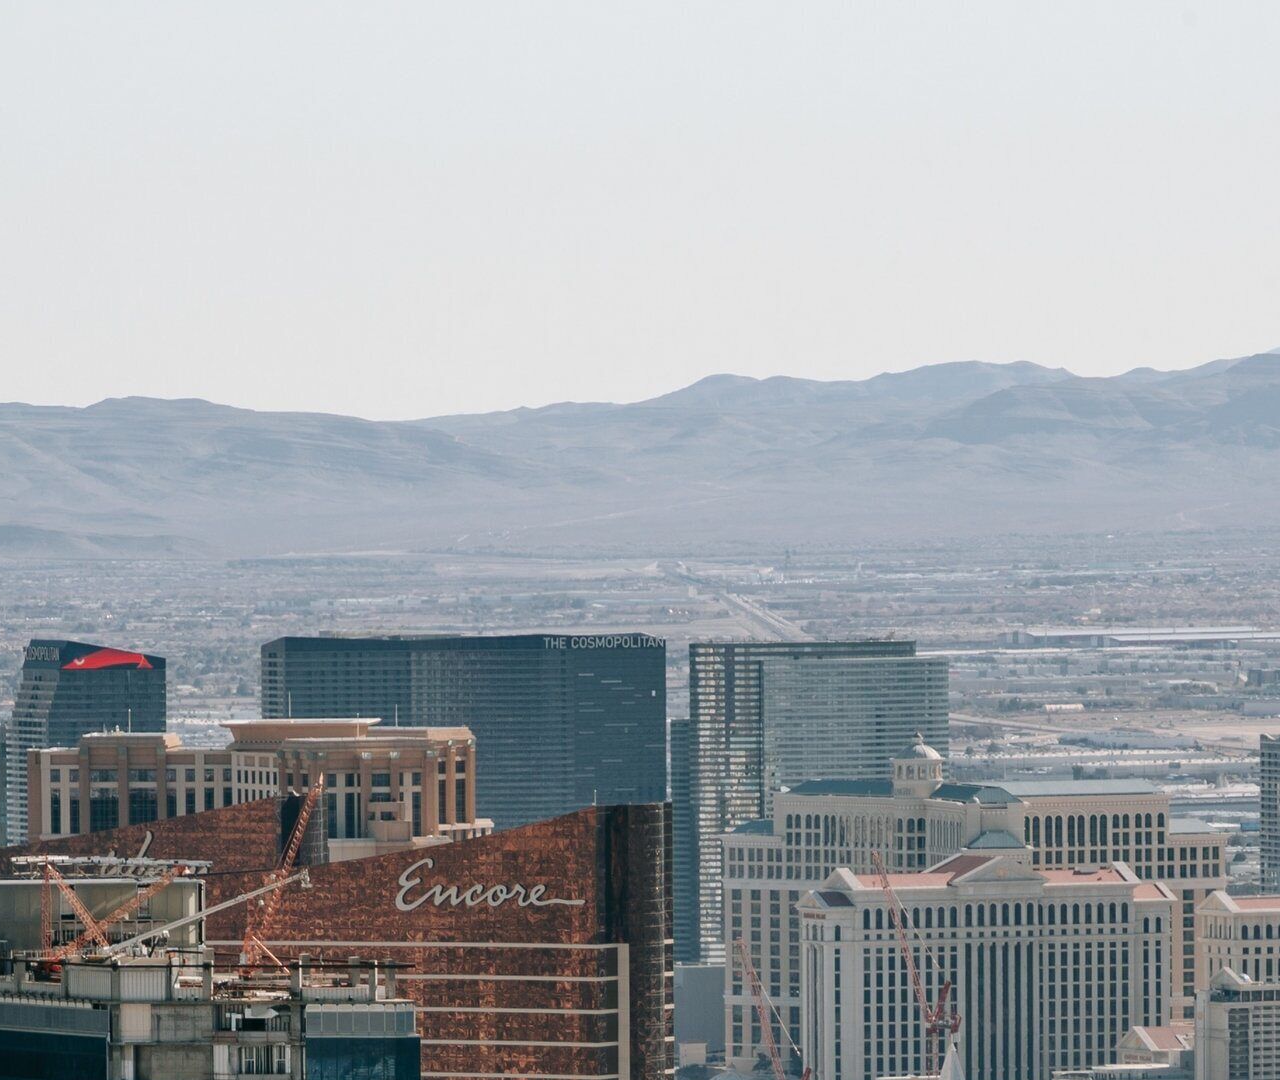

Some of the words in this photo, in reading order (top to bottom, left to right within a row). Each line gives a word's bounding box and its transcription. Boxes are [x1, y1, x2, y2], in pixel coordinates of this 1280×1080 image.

[543, 637, 567, 648] THE
[571, 635, 664, 648] COSMOPOLITAN
[395, 857, 586, 911] Encore
